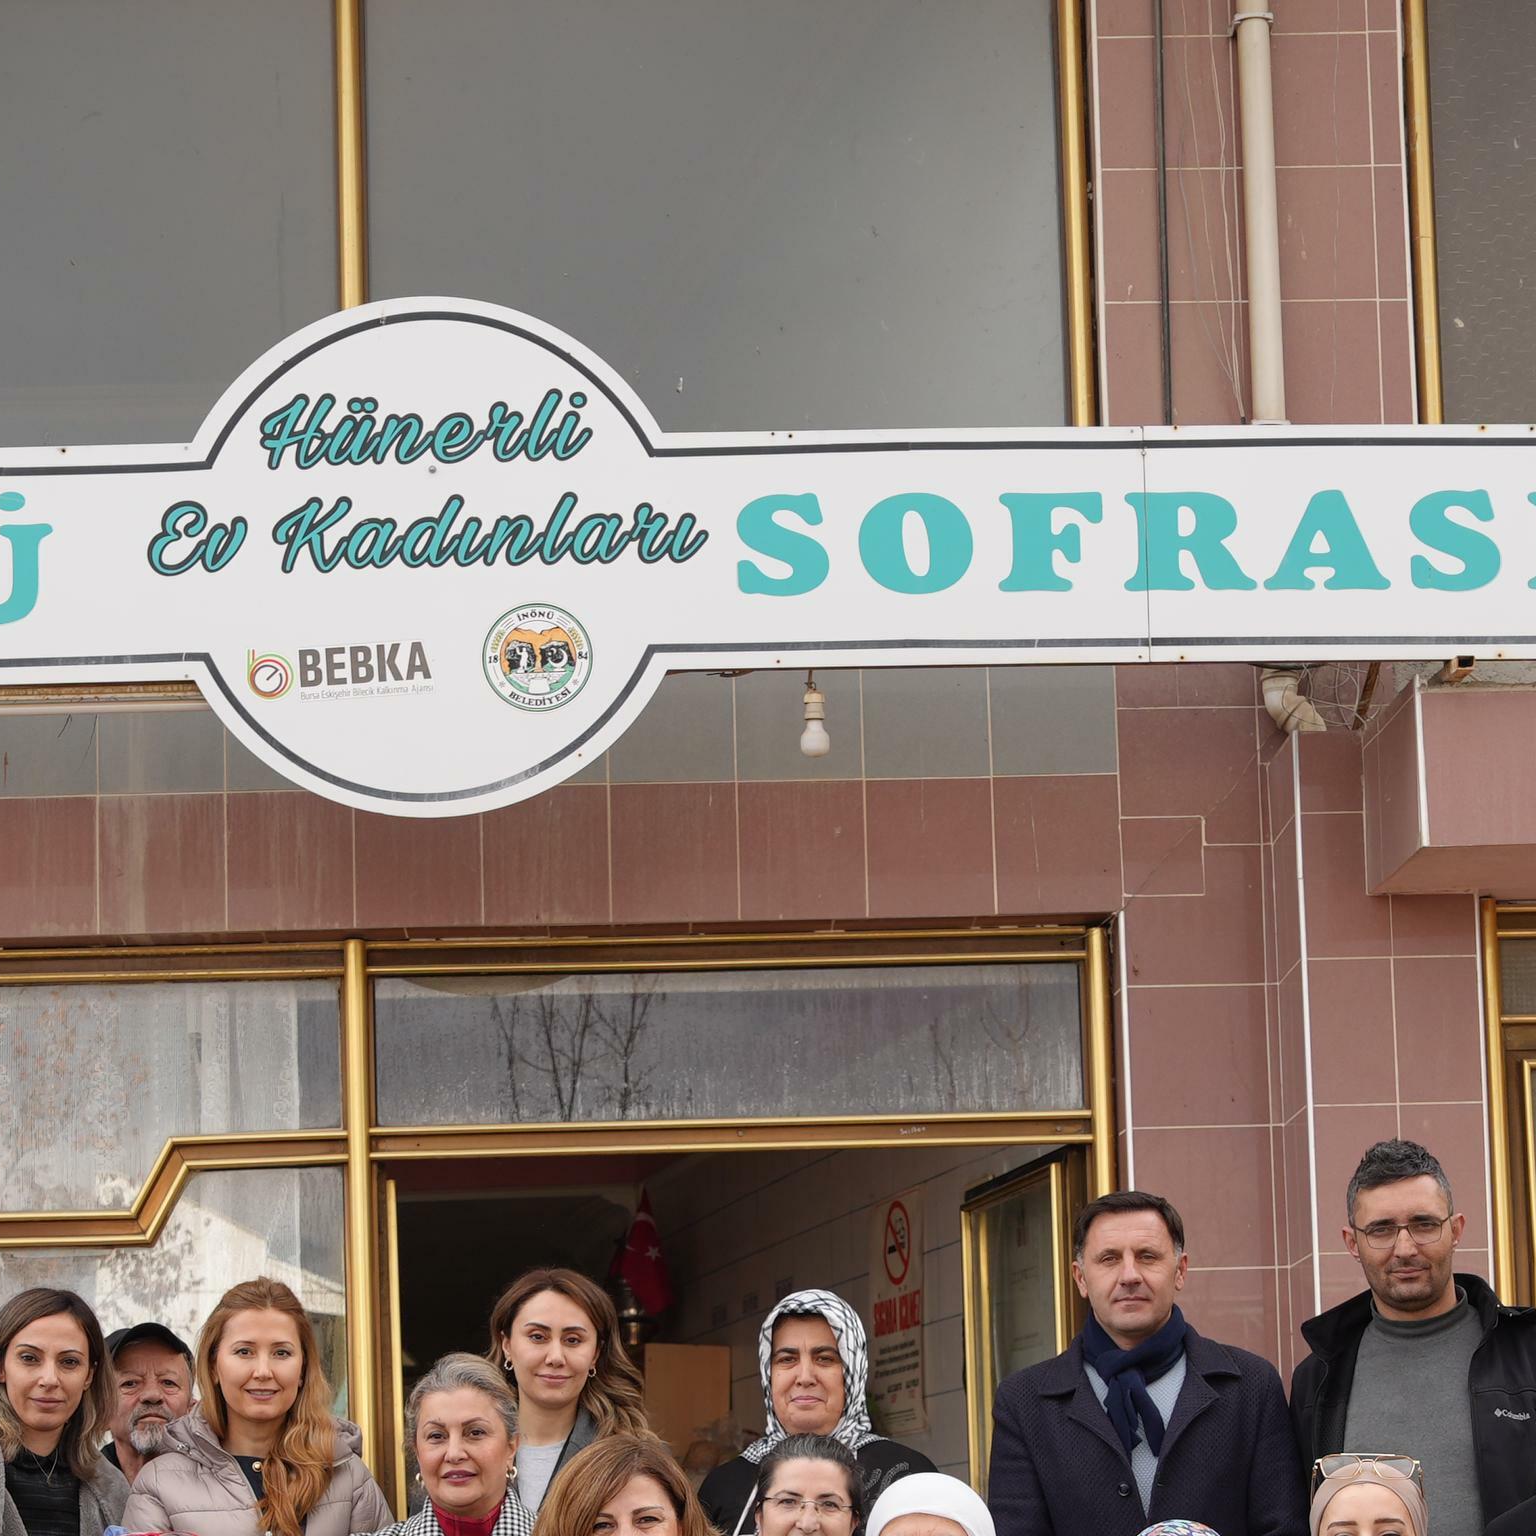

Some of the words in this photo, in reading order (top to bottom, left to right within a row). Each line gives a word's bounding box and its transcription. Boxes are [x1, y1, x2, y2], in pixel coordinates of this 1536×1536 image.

[259, 387, 594, 471] Hünerli
[147, 500, 248, 577] Ev
[271, 491, 709, 574] Kadınları
[516, 609, 555, 621] İNÖNÜ
[298, 641, 432, 688] BEBKA
[488, 654, 499, 664] 18
[508, 687, 572, 707] BELEDİYESİ
